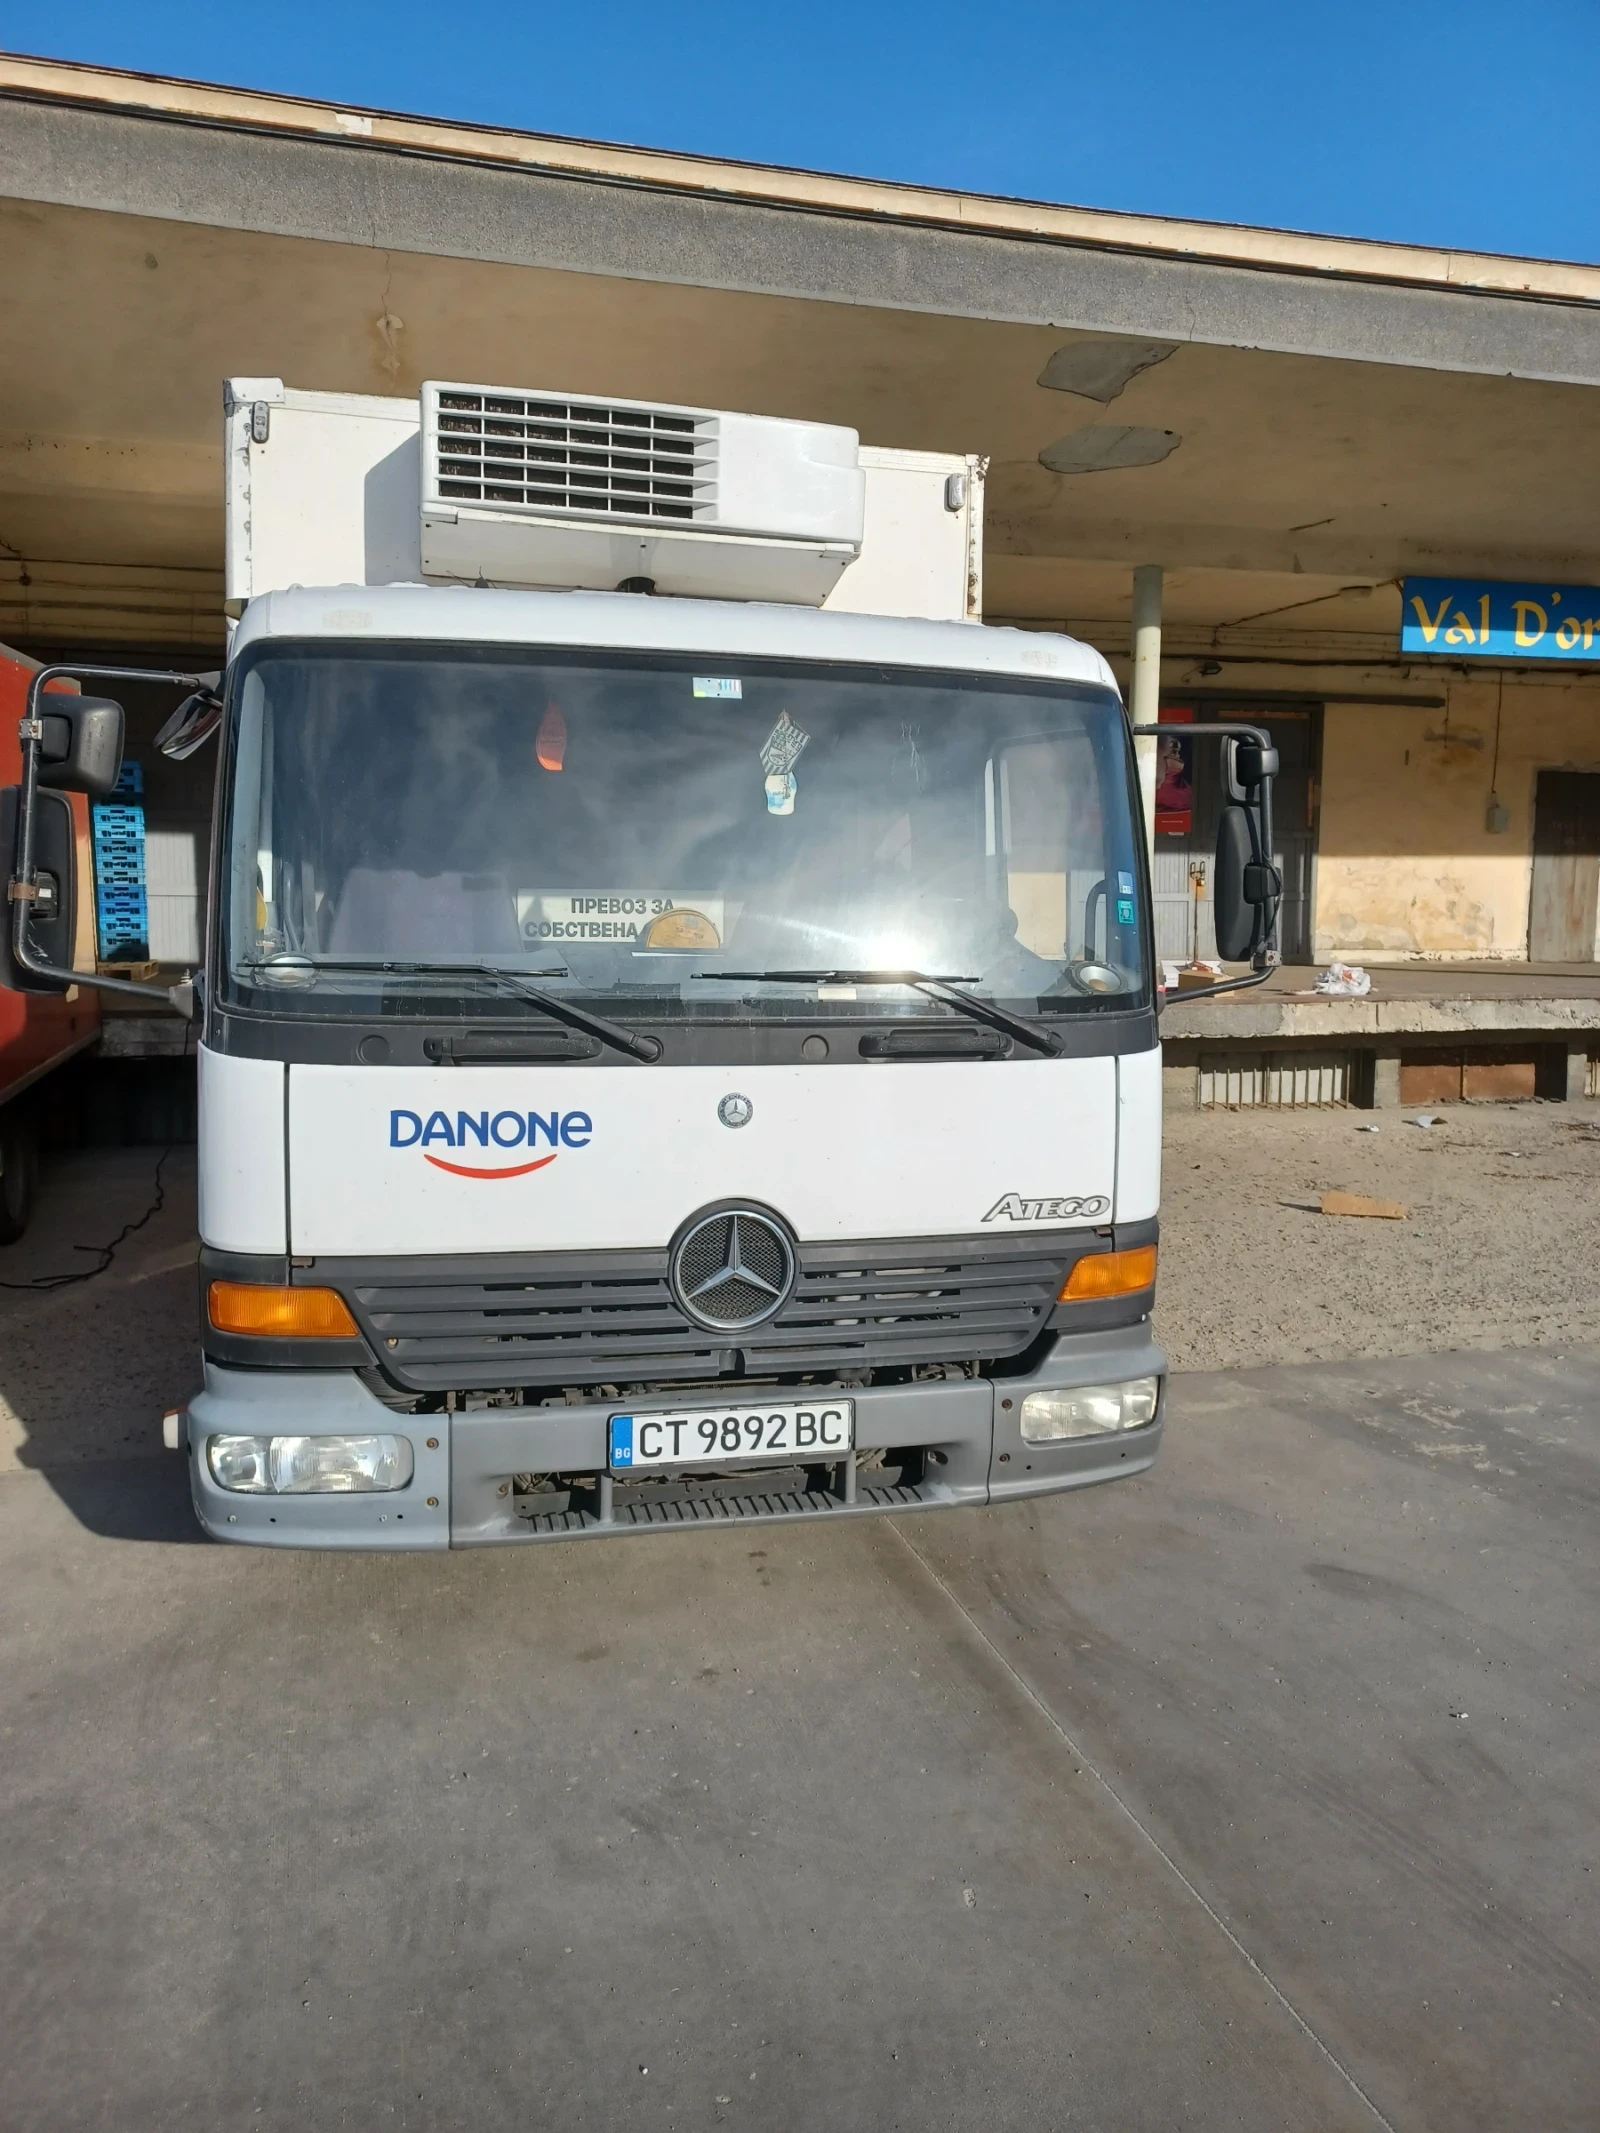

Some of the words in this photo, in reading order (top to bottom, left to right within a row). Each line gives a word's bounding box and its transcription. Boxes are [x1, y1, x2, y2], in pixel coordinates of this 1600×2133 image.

[1410, 594, 1490, 645] Val
[571, 898, 647, 914] ПРЕВОЗ
[651, 898, 674, 914] ЗА
[524, 922, 639, 938] СОБСТВЕНА
[981, 1192, 1110, 1222] ATEGO
[639, 1420, 688, 1458] CT
[698, 1414, 787, 1453] 9892
[795, 1410, 842, 1446] BC
[615, 1447, 631, 1459] BG
